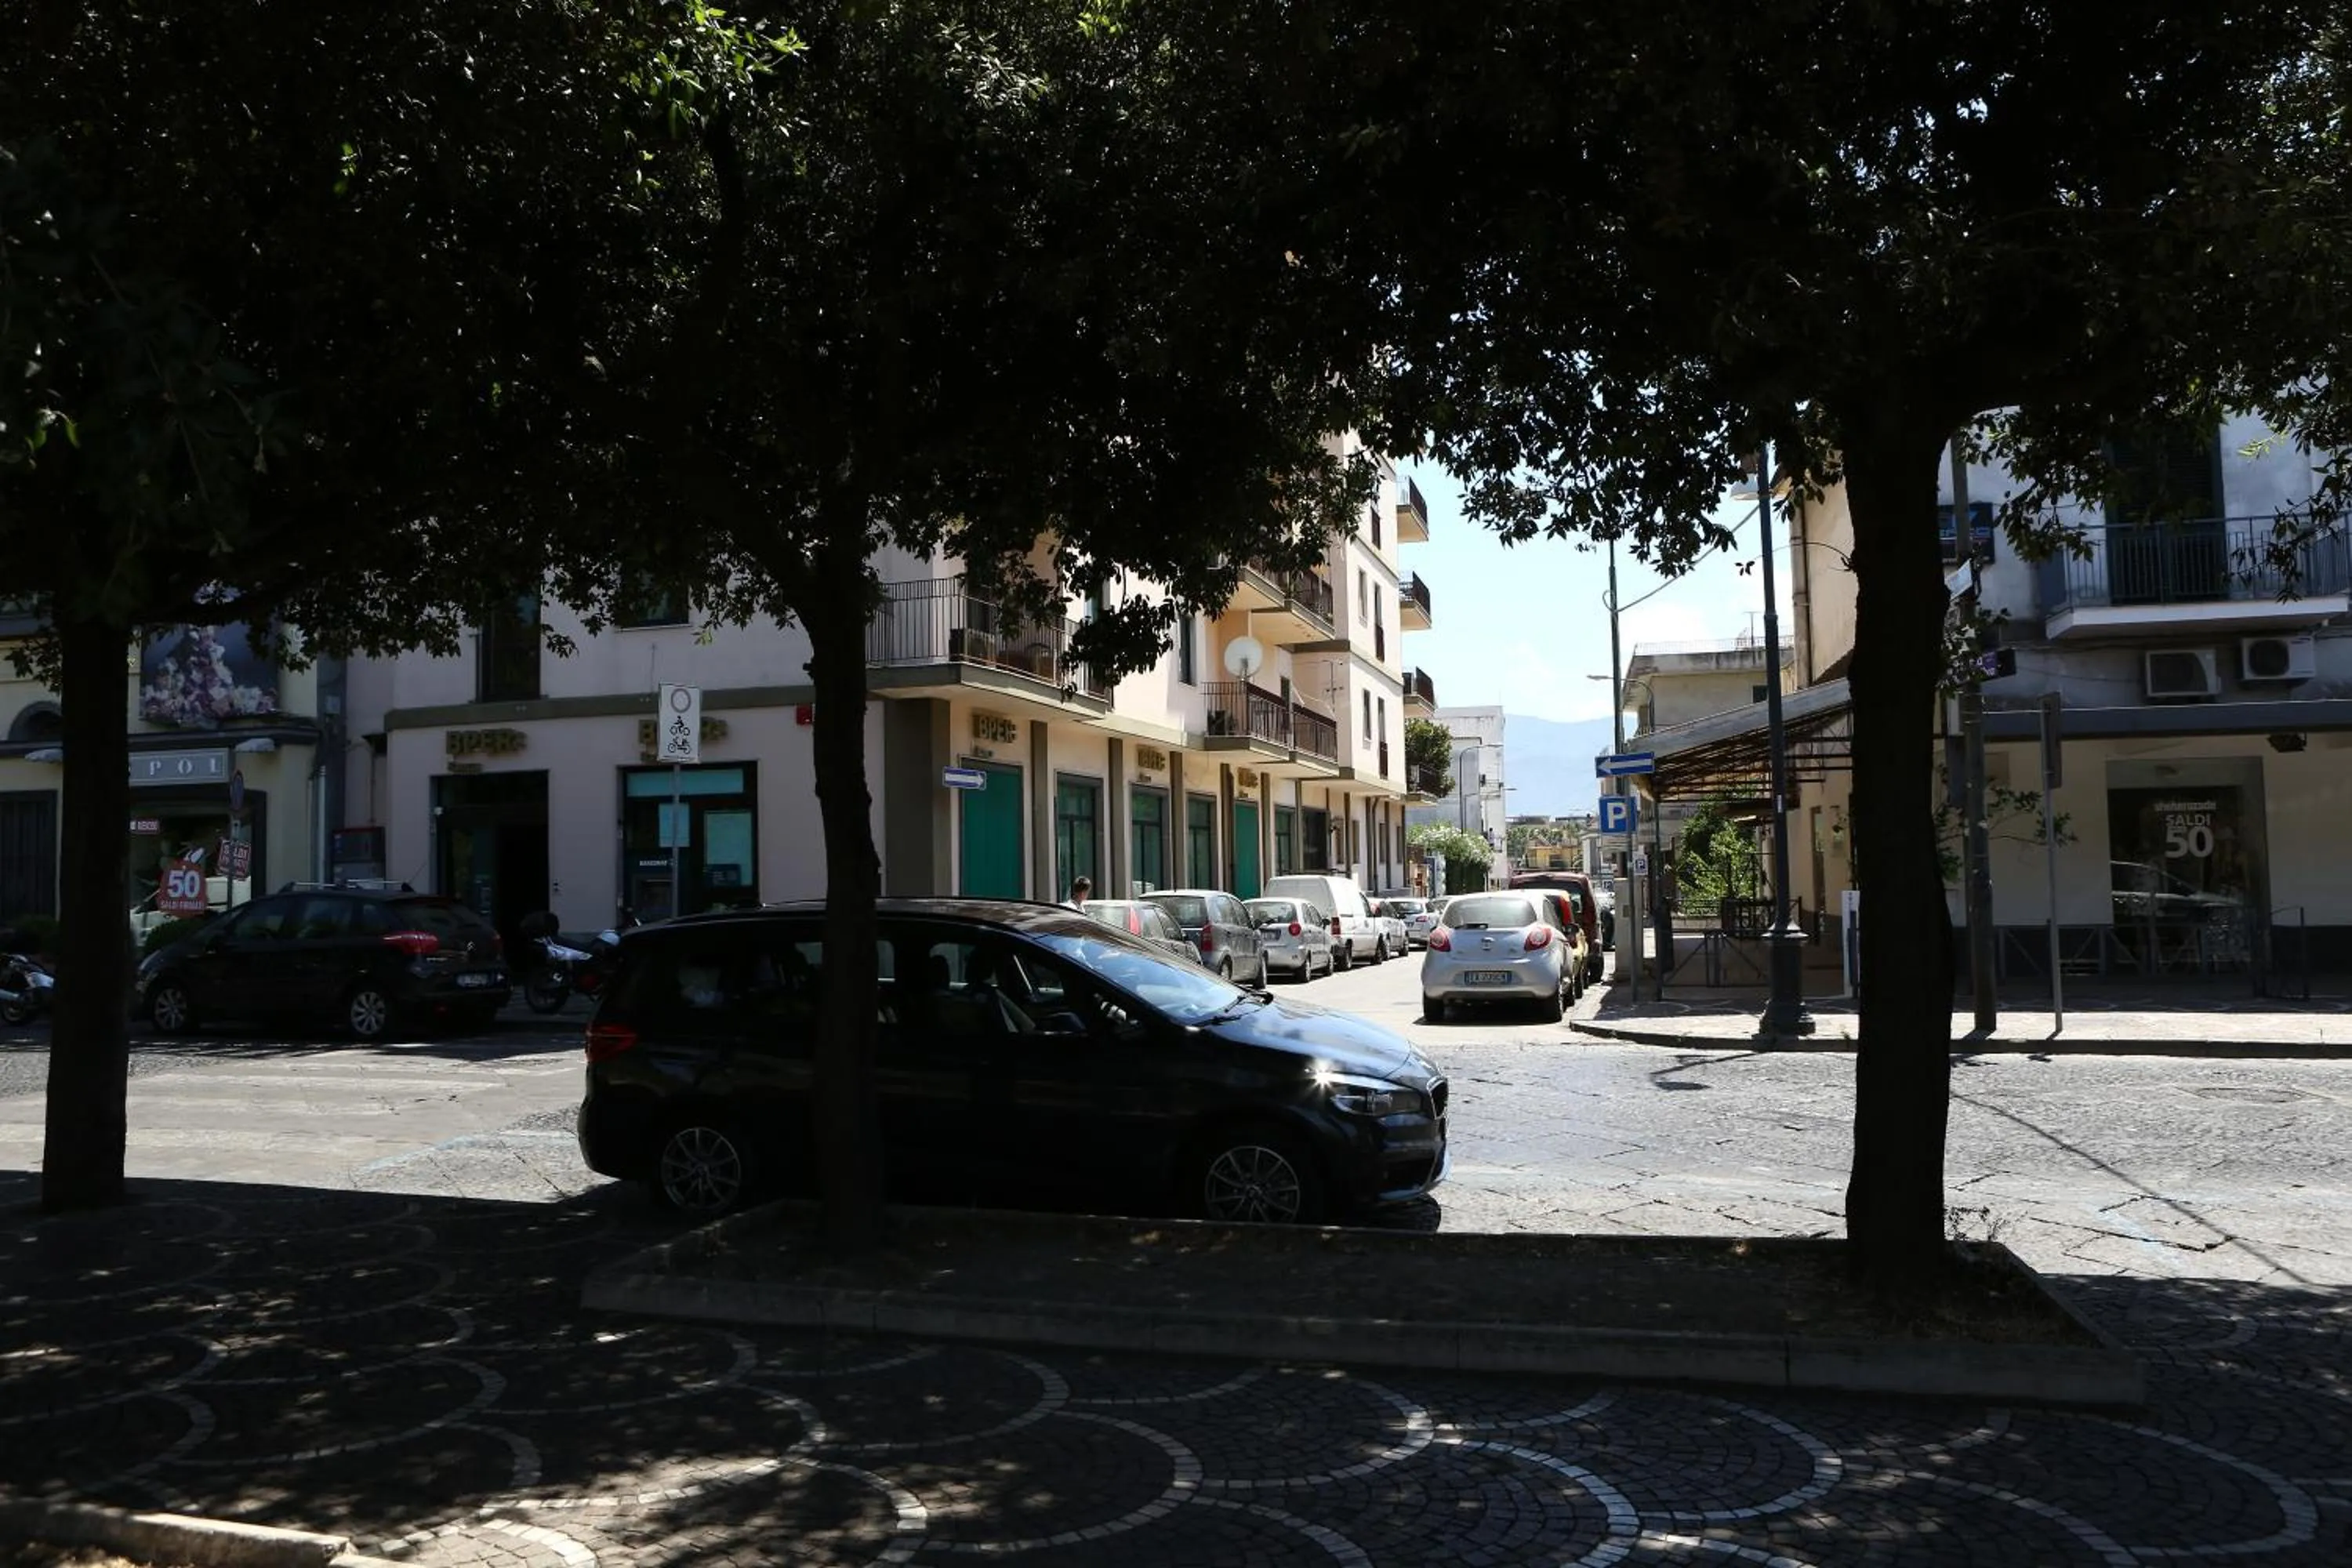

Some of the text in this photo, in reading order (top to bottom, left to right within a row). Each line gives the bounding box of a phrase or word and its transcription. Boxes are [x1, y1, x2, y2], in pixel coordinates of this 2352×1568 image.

[128, 757, 221, 776] POL
[1607, 802, 1627, 829] P
[2165, 813, 2211, 826] SALDI
[2165, 826, 2213, 858] 50
[167, 869, 201, 898] 50
